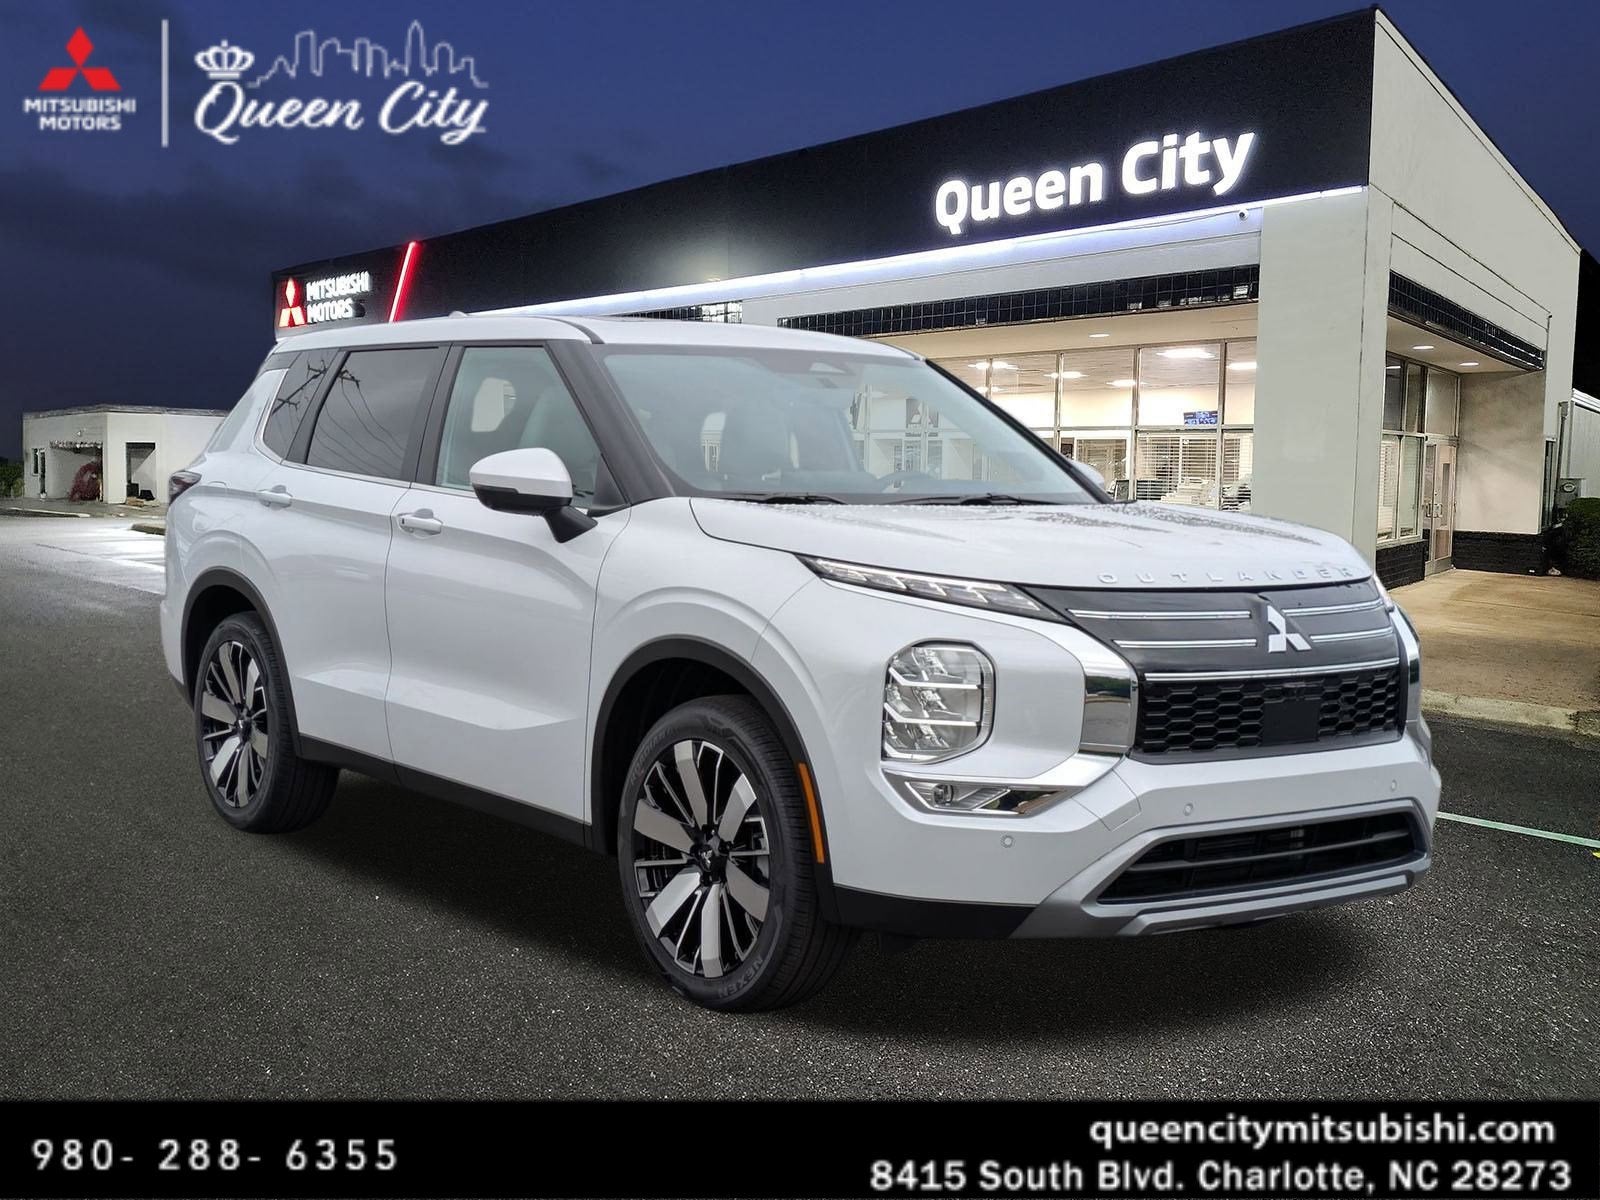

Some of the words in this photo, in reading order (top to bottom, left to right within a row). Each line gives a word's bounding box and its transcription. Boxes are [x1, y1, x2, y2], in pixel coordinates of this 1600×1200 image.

[935, 162, 1103, 234] Queen
[1121, 131, 1255, 196] City
[306, 271, 371, 301] MITSUBISHI
[306, 298, 354, 323] MOTORS
[1099, 566, 1353, 584] OUTLANDER
[718, 955, 763, 998] NEXEN
